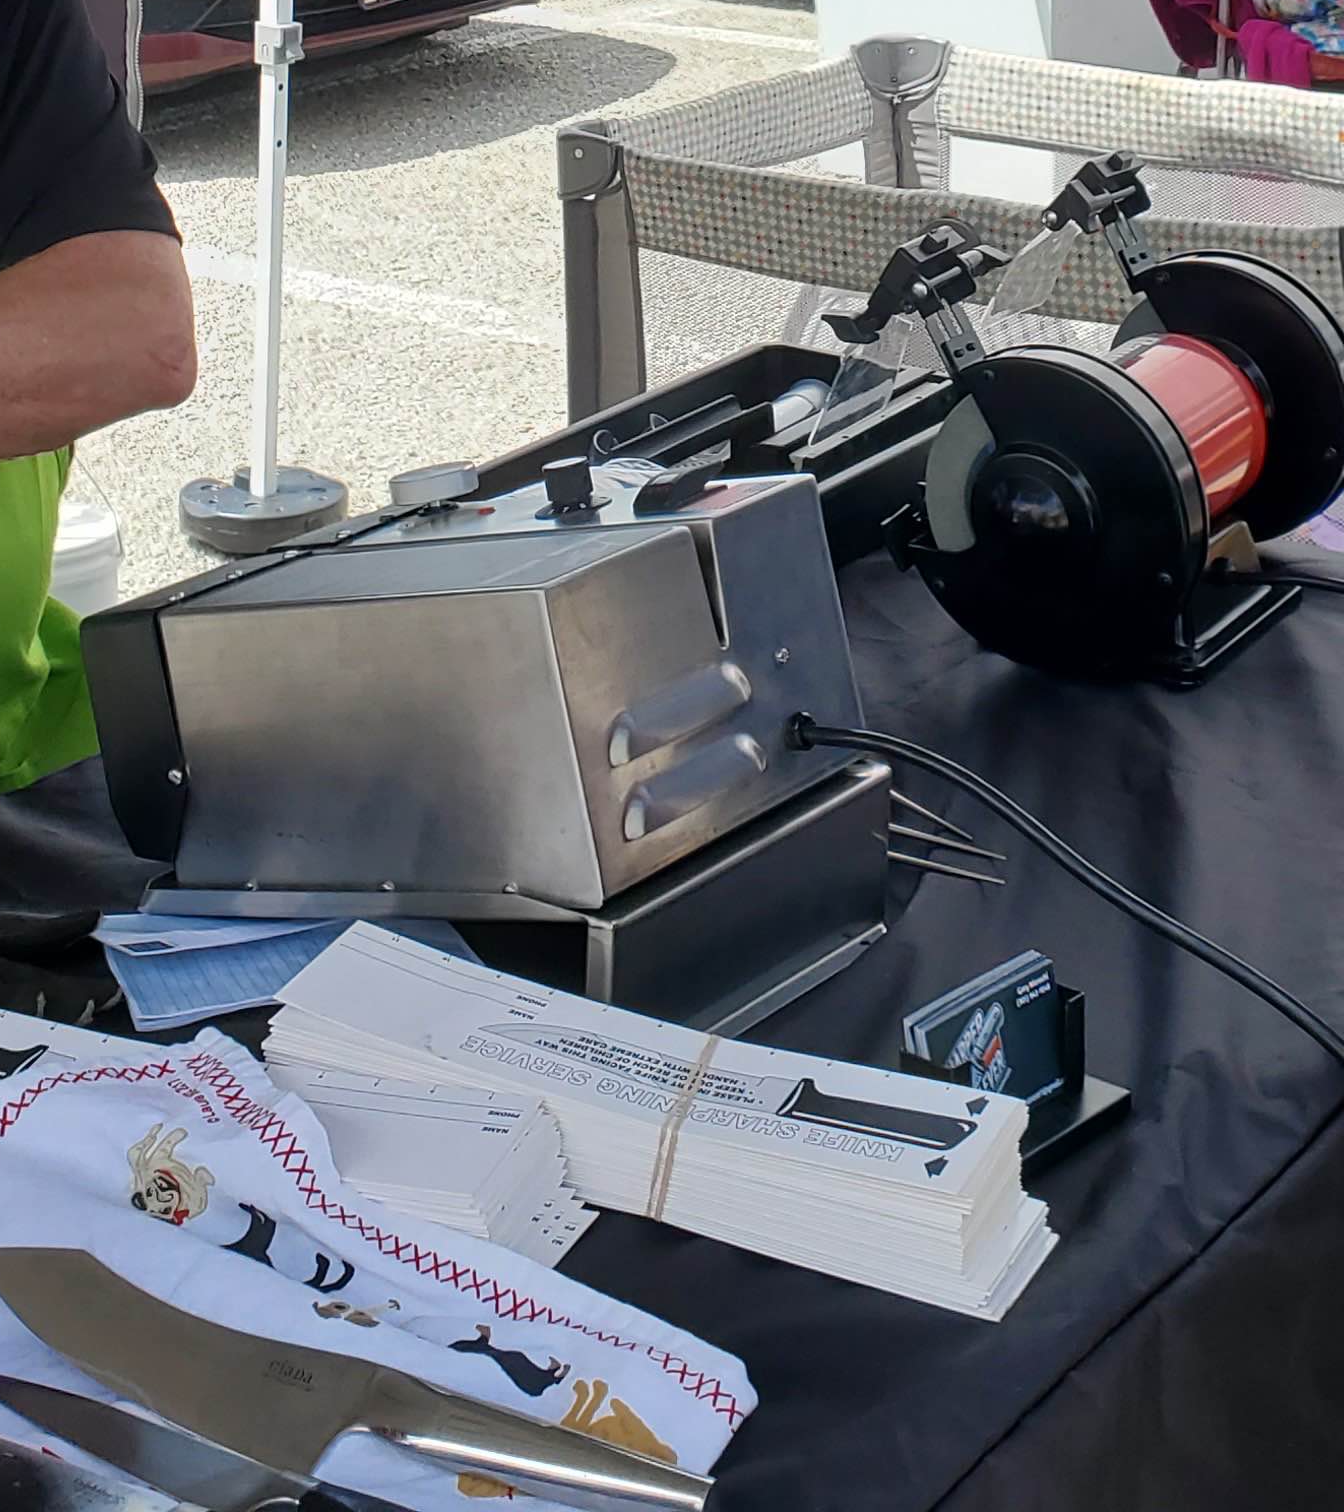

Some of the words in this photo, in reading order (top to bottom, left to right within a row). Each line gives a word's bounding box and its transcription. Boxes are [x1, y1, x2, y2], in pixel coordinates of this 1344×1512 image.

[515, 994, 547, 1007] PHONE
[507, 1008, 534, 1020] NAME
[534, 1038, 558, 1050] WAY
[558, 1037, 613, 1058] CHILDREN
[577, 1036, 607, 1049] CARE
[560, 1046, 586, 1059] THIS
[608, 1045, 660, 1065] EXTREME
[459, 1035, 593, 1087] SERVICE
[589, 1055, 631, 1072] FACING
[613, 1055, 631, 1064] OF
[631, 1060, 671, 1076] REACH
[662, 1061, 691, 1074] WITH
[633, 1069, 668, 1084] KNIFE
[671, 1073, 688, 1081] OF
[669, 1078, 711, 1095] INRT
[714, 1084, 745, 1094] KEEP
[711, 1090, 755, 1104] PLEASE
[488, 1110, 520, 1119] PHONE
[597, 1077, 802, 1139] SHARPNING
[481, 1126, 510, 1134] NAME
[802, 1129, 905, 1162] KNIFE
